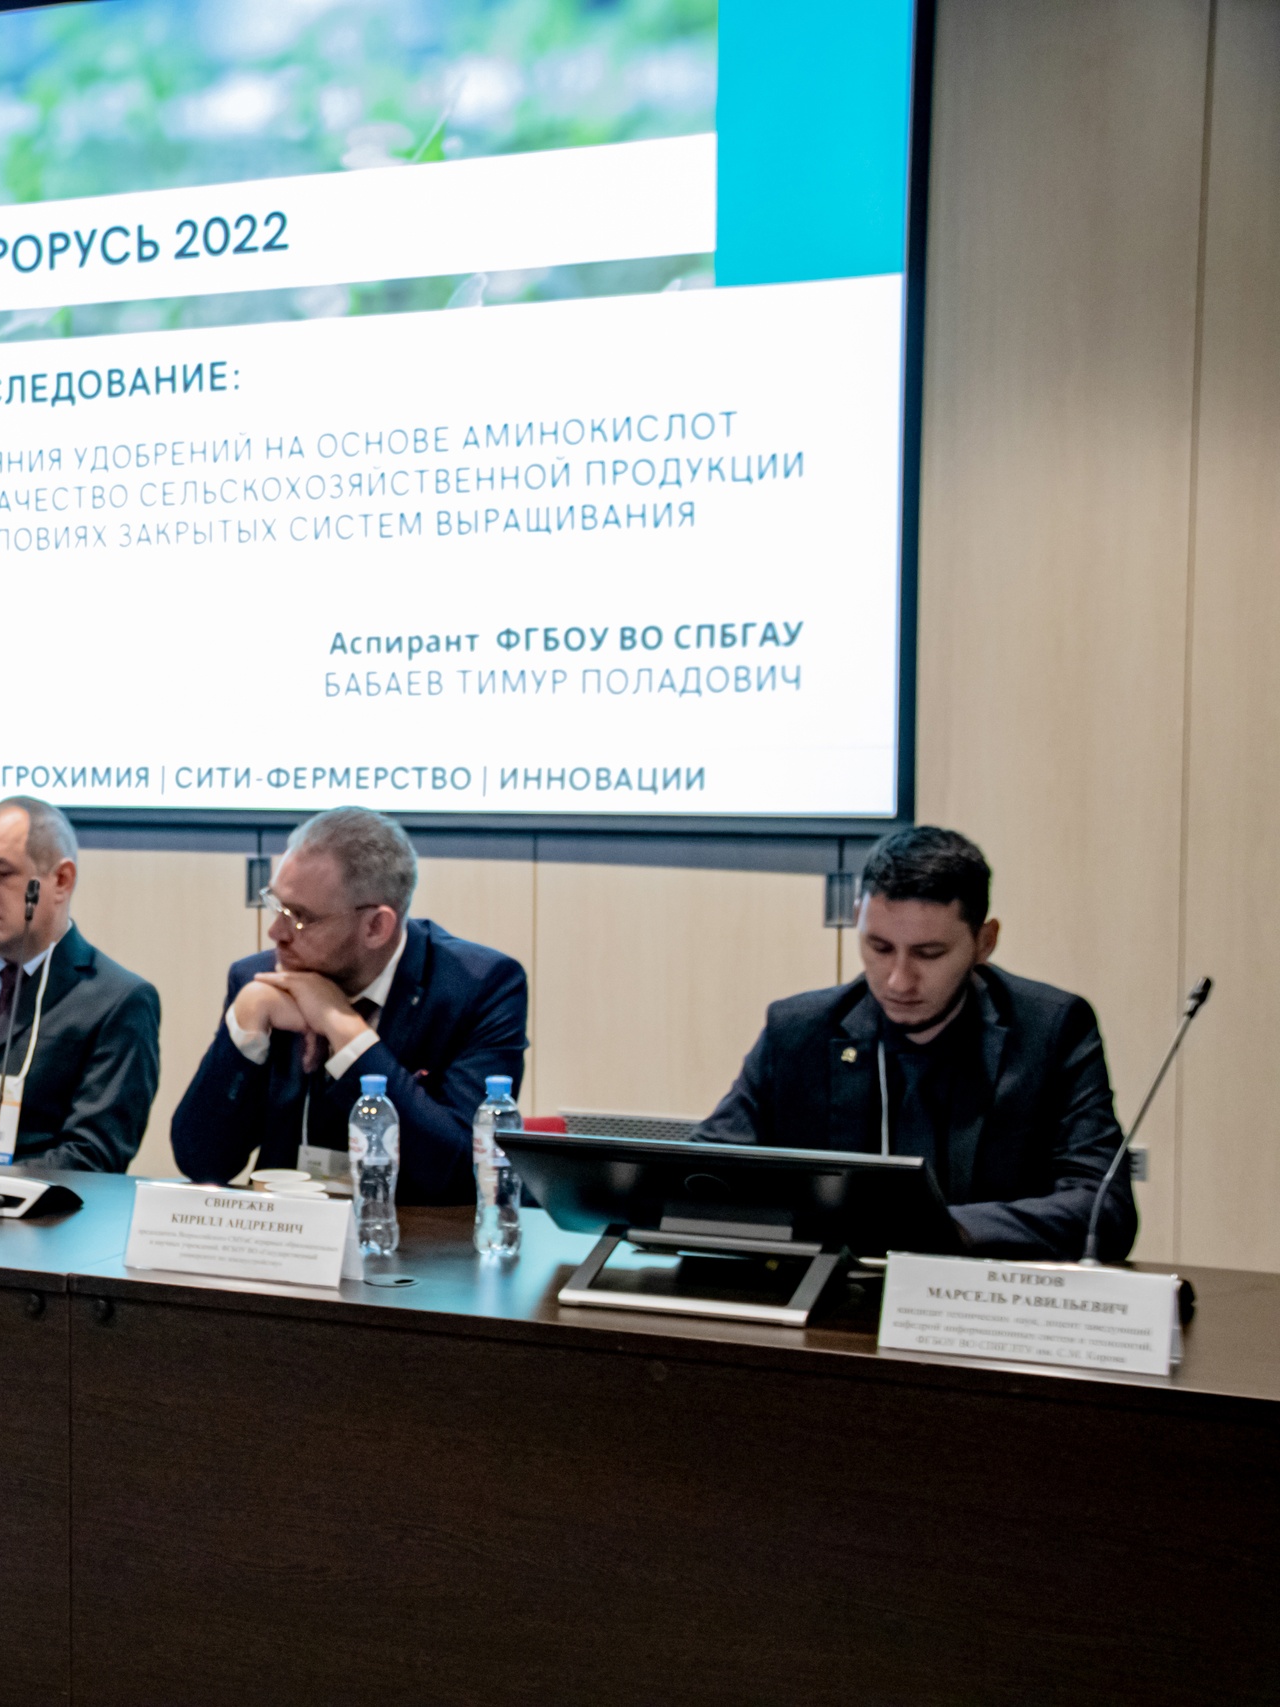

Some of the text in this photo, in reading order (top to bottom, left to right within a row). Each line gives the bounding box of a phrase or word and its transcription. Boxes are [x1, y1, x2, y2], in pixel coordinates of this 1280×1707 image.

[173, 210, 290, 260] 2022
[74, 432, 252, 474] УДОБРЕНИЙ
[266, 435, 305, 460] НА
[317, 426, 449, 458] ОСНОВЕ
[462, 411, 737, 450] АМИНОКИСЛОТ
[140, 456, 570, 506] СЕЛЬСКОХОЗЯЙСТВЕННОЙ
[586, 451, 805, 489] ПРОДУКЦИИ
[119, 518, 277, 548] ЗАКРЫТЫХ
[289, 512, 422, 541] СИСТЕМ
[437, 501, 696, 536] ВЫРАЩИВАНИЯ
[329, 620, 804, 661] Аспирант ФГБОУ ВО СПБГАУ
[325, 664, 802, 698] БАБАЕВ ТИМУР ПОЛАДОВИЧ
[175, 765, 472, 791] СИТИ-ФЕРМЕРСТВО
[500, 766, 706, 795] ИННОВАЦИИ
[204, 1197, 275, 1212] СВИРЕЖЕВ
[170, 1213, 304, 1234] КИРИЛЛ АНДРЕЕВИЧ
[987, 1270, 1065, 1288] ВАГИЗОВ
[927, 1286, 1129, 1315] МАРСЕЛЬ РАВИЛЬЕВИЧ
